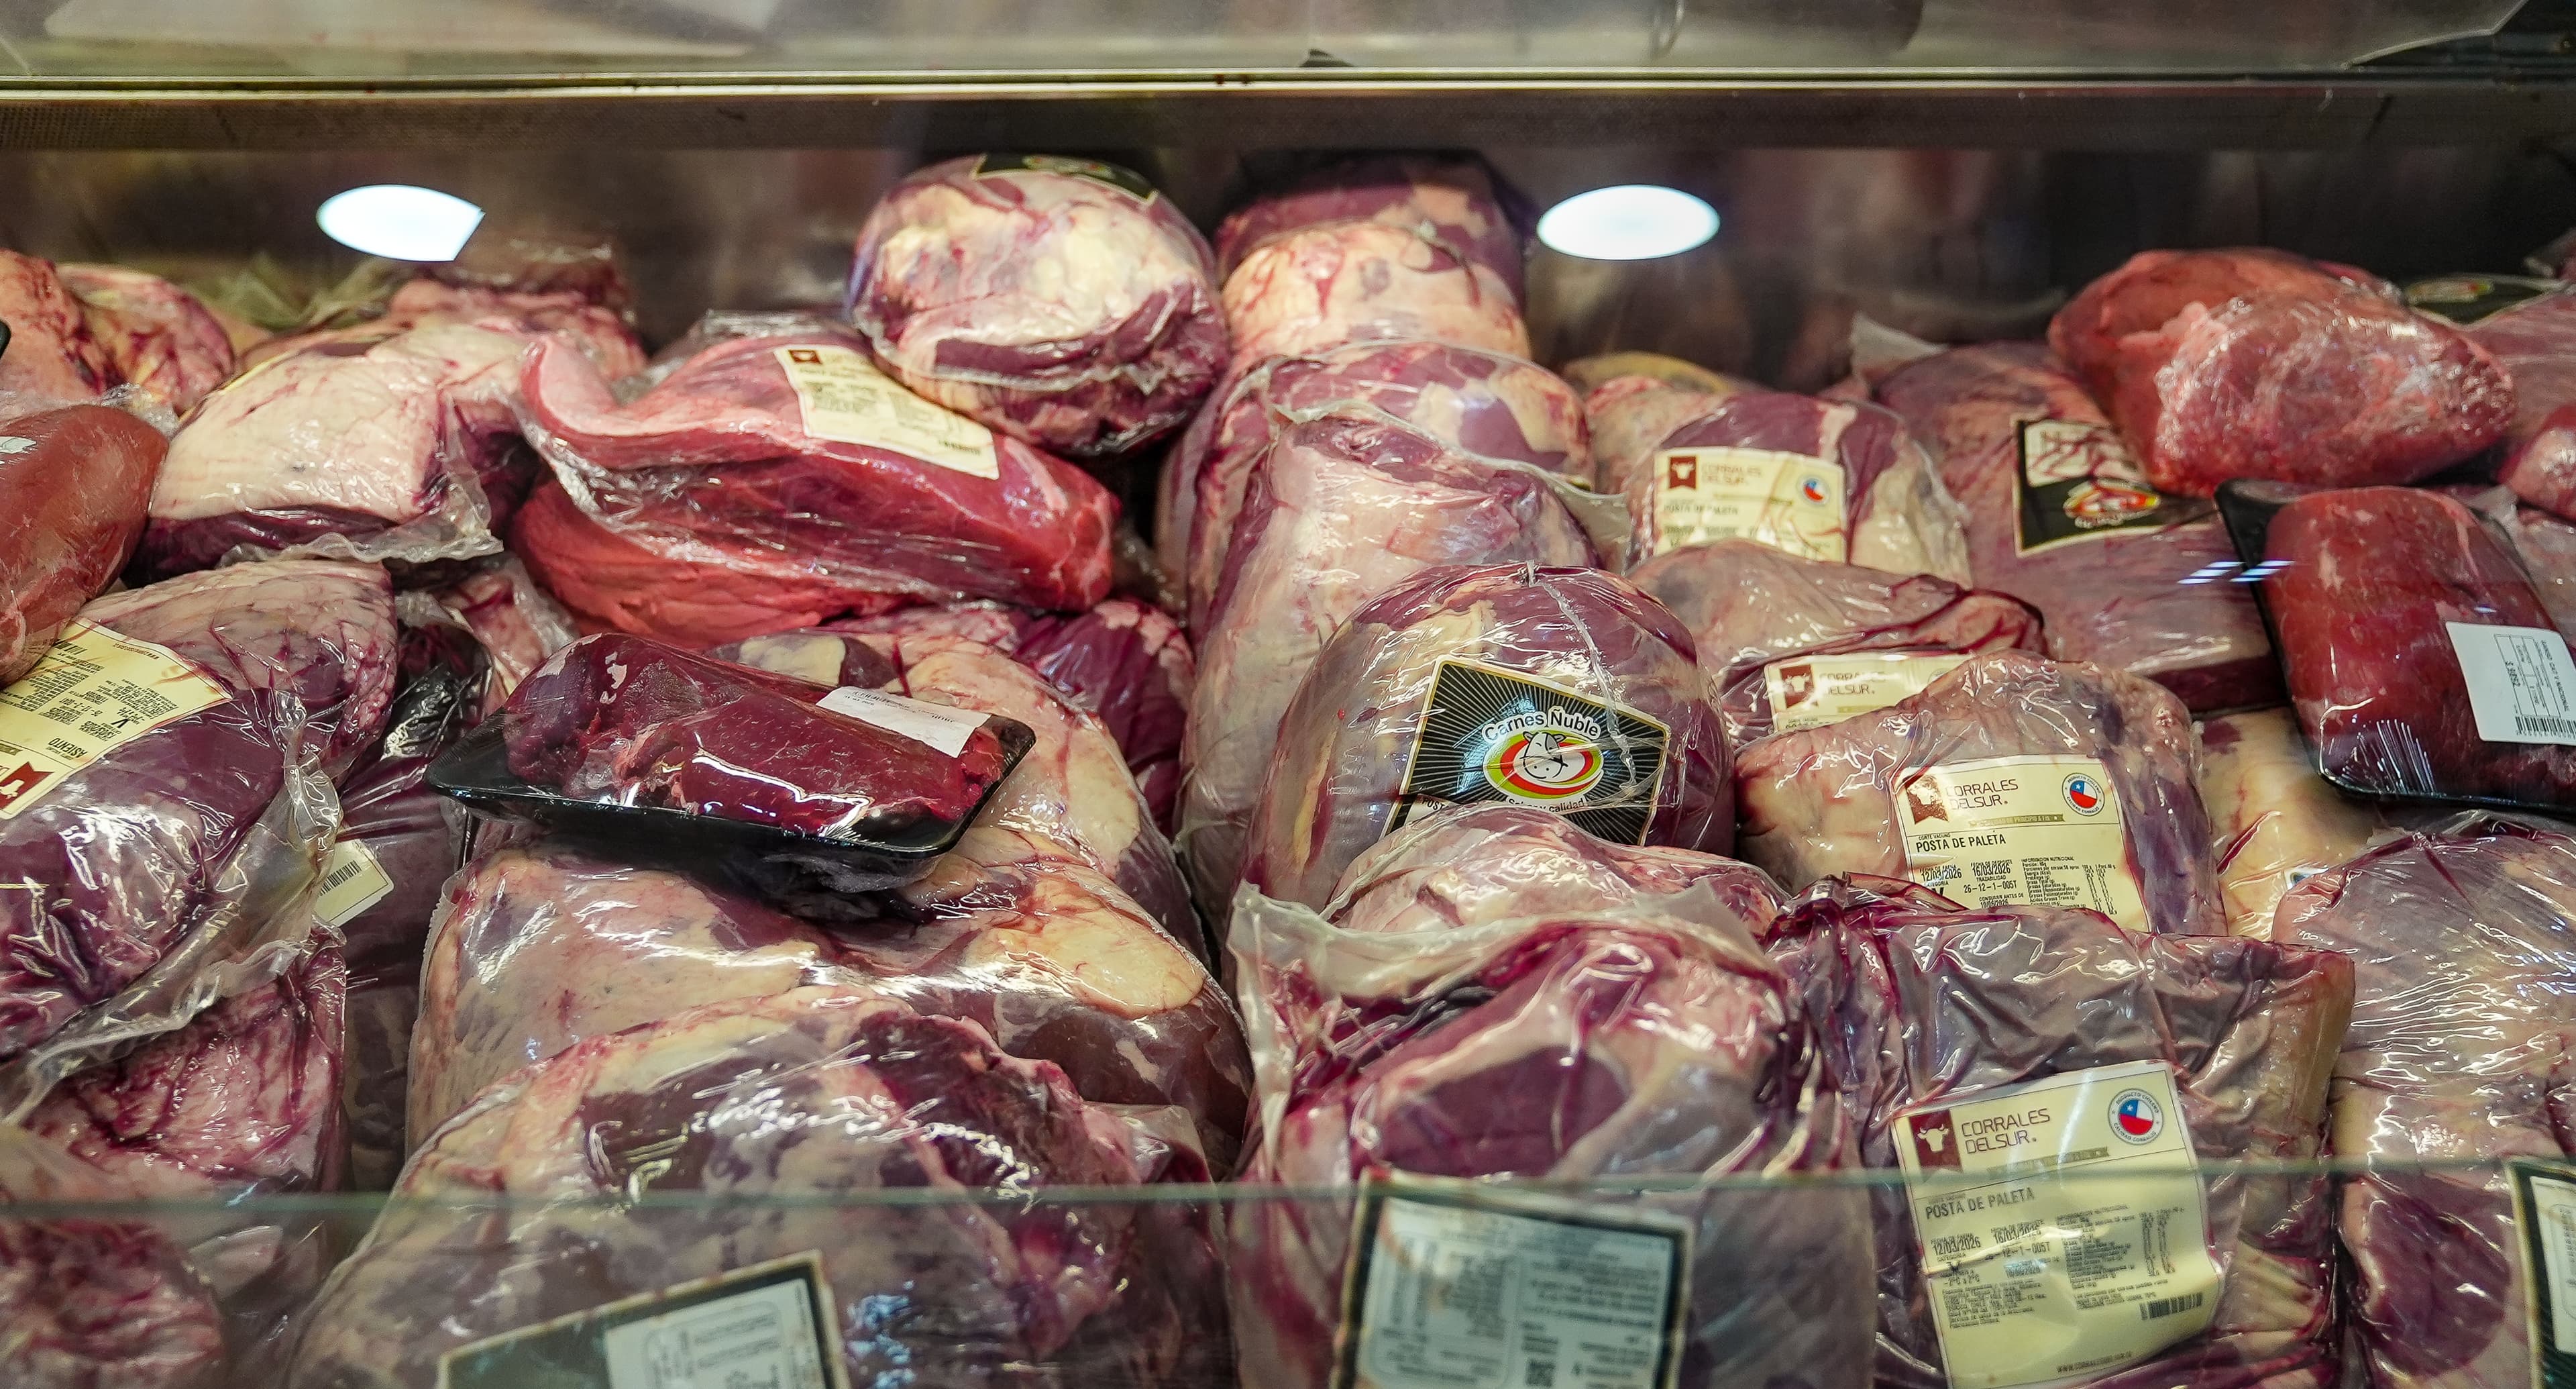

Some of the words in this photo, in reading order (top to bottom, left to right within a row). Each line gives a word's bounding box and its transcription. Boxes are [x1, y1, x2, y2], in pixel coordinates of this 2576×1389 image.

[111, 718, 128, 728] V
[1485, 714, 1545, 741] Carnes
[1550, 708, 1599, 737] Ñuble
[48, 737, 88, 758] ASIENTO
[1946, 778, 2019, 796] CORRALES
[1422, 797, 1446, 811] POST
[1549, 798, 1584, 813] calidad
[1916, 839, 1950, 853] POSTA
[1952, 837, 1966, 848] DE
[1969, 834, 2006, 847] PALETA
[1921, 868, 1962, 881] 12/03/2026
[1972, 863, 2011, 876] 16/03/2026
[1962, 1108, 2050, 1137] CORRALES
[1926, 1201, 1964, 1219] POSTA
[1968, 1198, 1985, 1212] DE
[1987, 1187, 2035, 1208] PALETA
[1933, 1236, 1981, 1256] 12/03/2026
